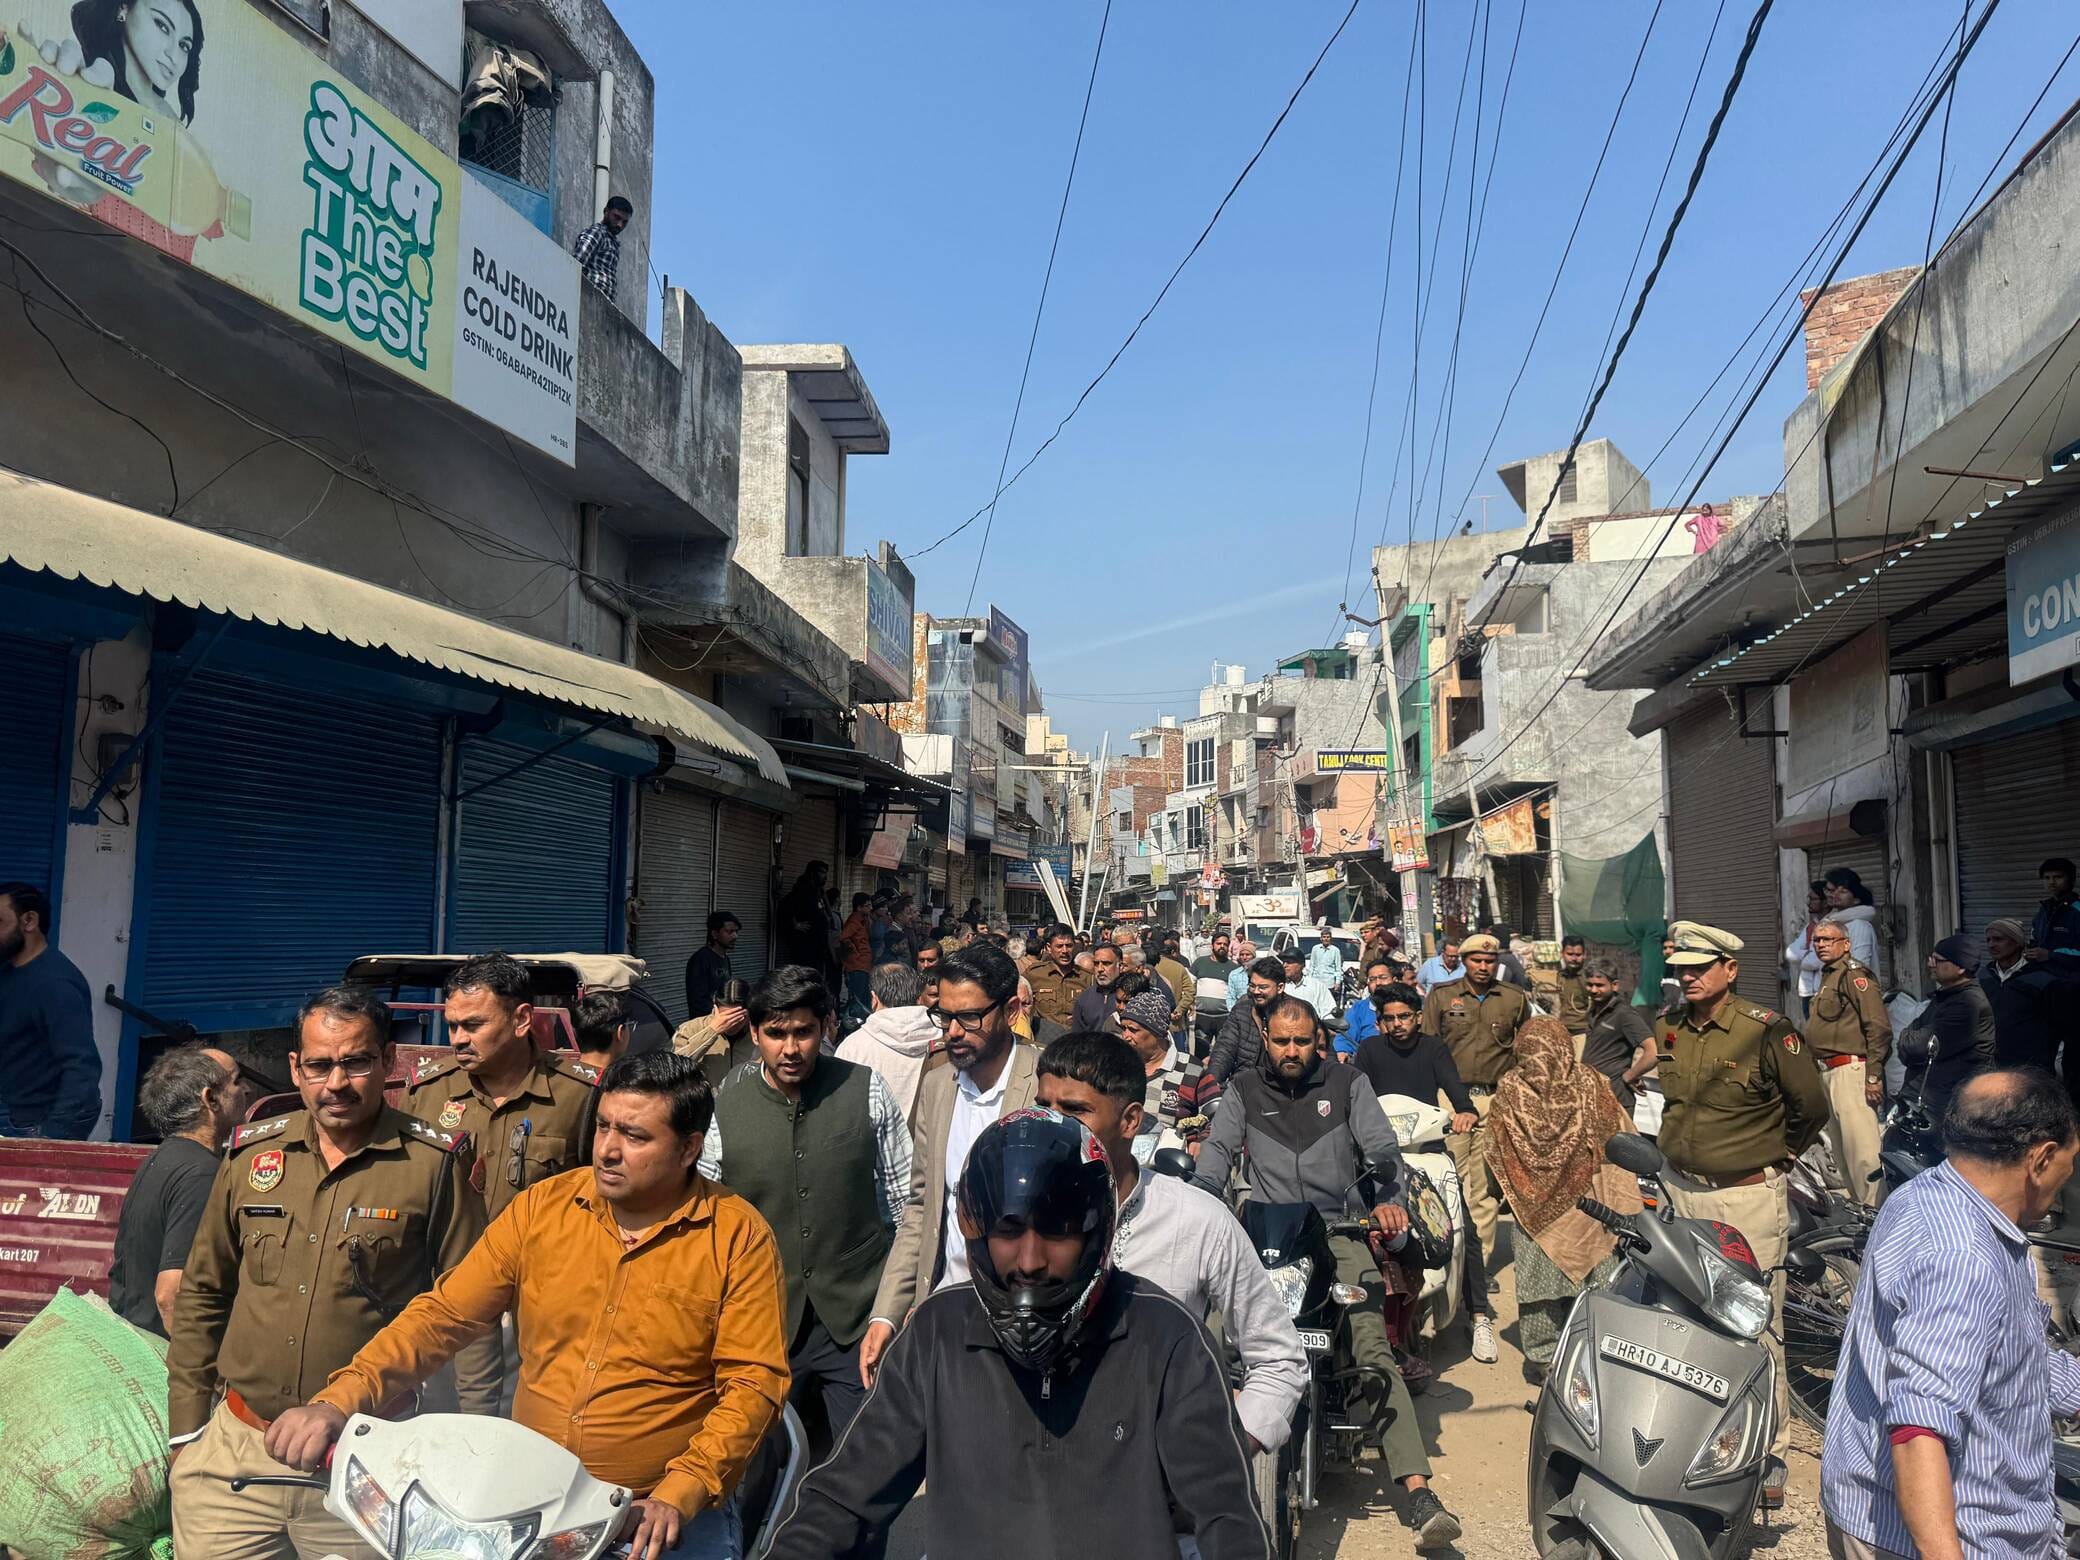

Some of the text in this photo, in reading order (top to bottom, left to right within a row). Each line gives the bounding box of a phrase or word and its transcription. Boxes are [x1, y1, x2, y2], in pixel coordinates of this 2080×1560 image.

[0, 66, 152, 183] Real
[84, 163, 132, 193] Fruit Power
[308, 167, 403, 281] The
[304, 234, 424, 362] Best
[473, 246, 569, 340] RAJENDRA
[463, 286, 574, 382] COLD DRINK
[463, 327, 494, 359] GSTIN:
[21, 1249, 39, 1263] 207
[1262, 1248, 1280, 1257] TVS
[1298, 1334, 1326, 1347] 909
[1663, 1318, 1688, 1333] TVS
[1684, 1367, 1723, 1393] 5376
